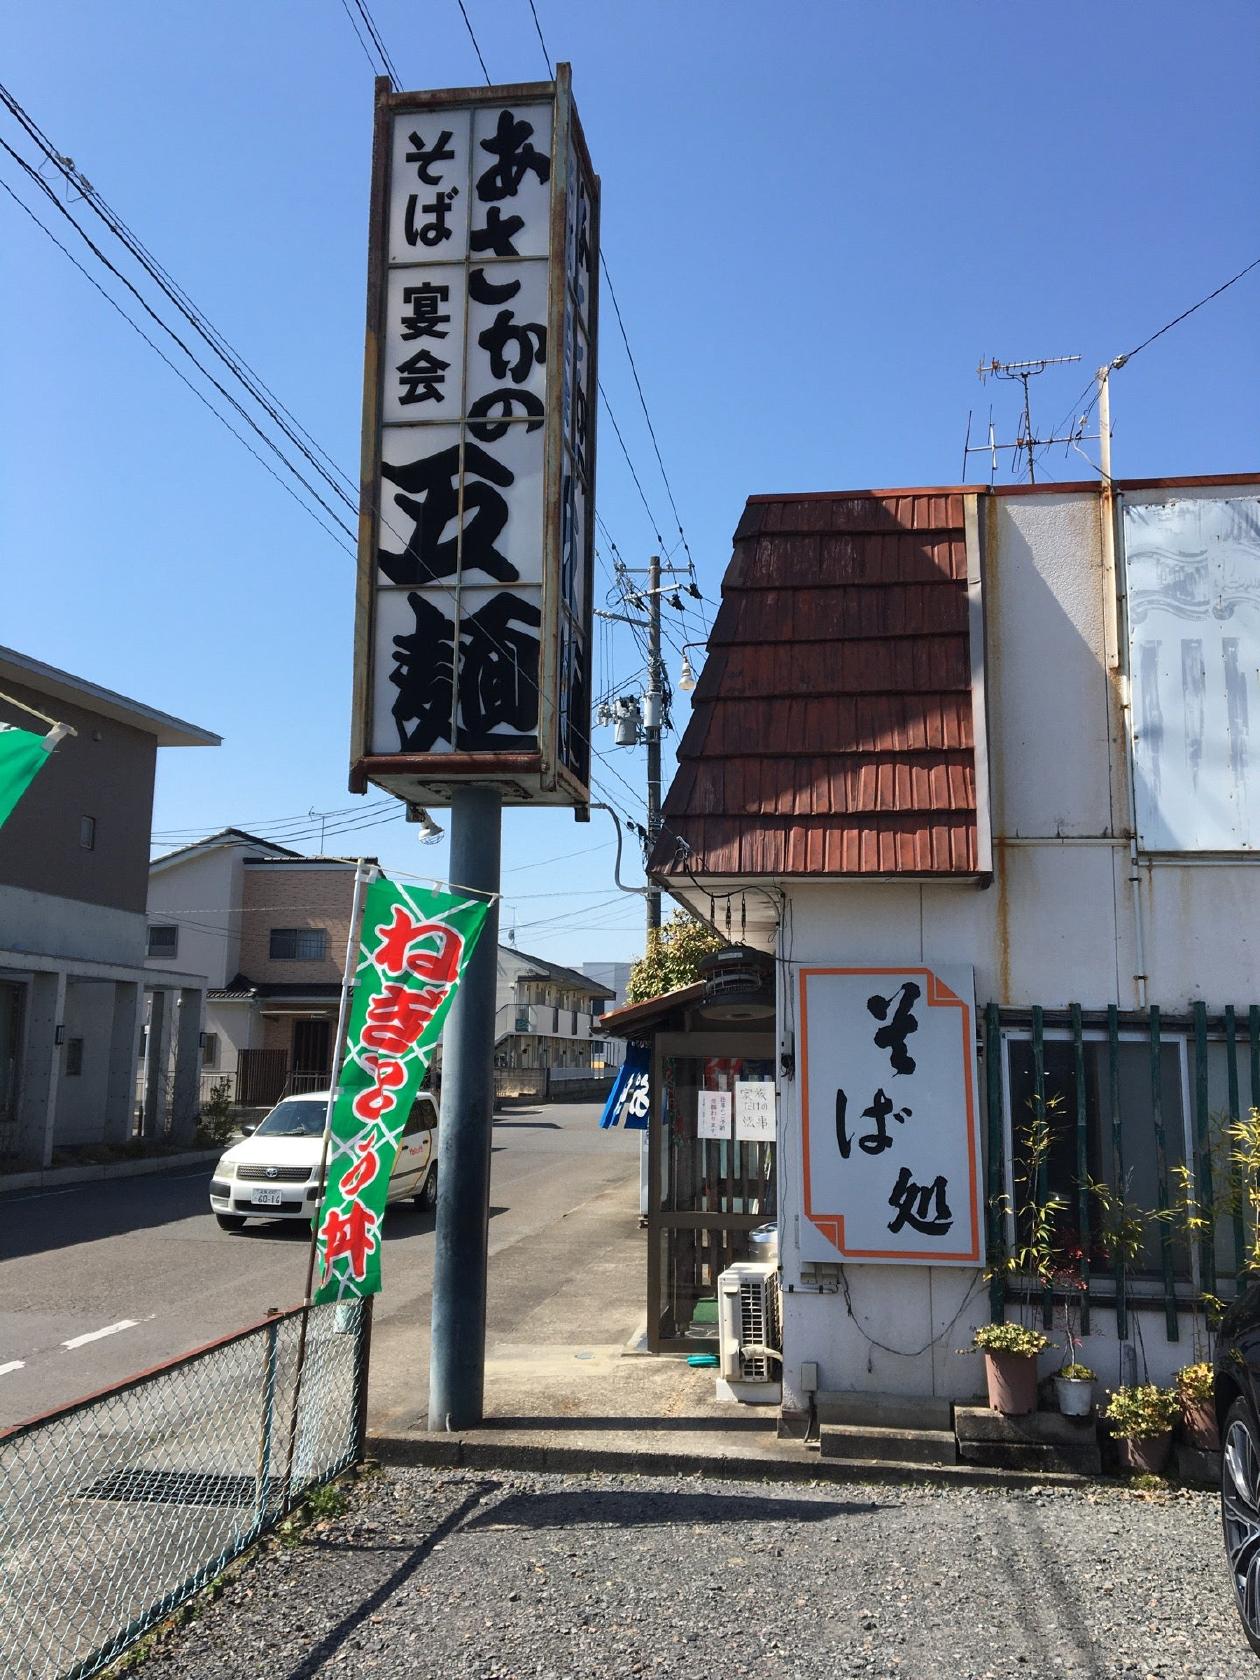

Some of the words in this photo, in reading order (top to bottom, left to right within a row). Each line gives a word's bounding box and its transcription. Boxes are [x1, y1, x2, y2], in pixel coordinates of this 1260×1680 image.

[405, 130, 459, 247] そば
[396, 281, 451, 406] 宴会
[836, 981, 954, 1237] そば処
